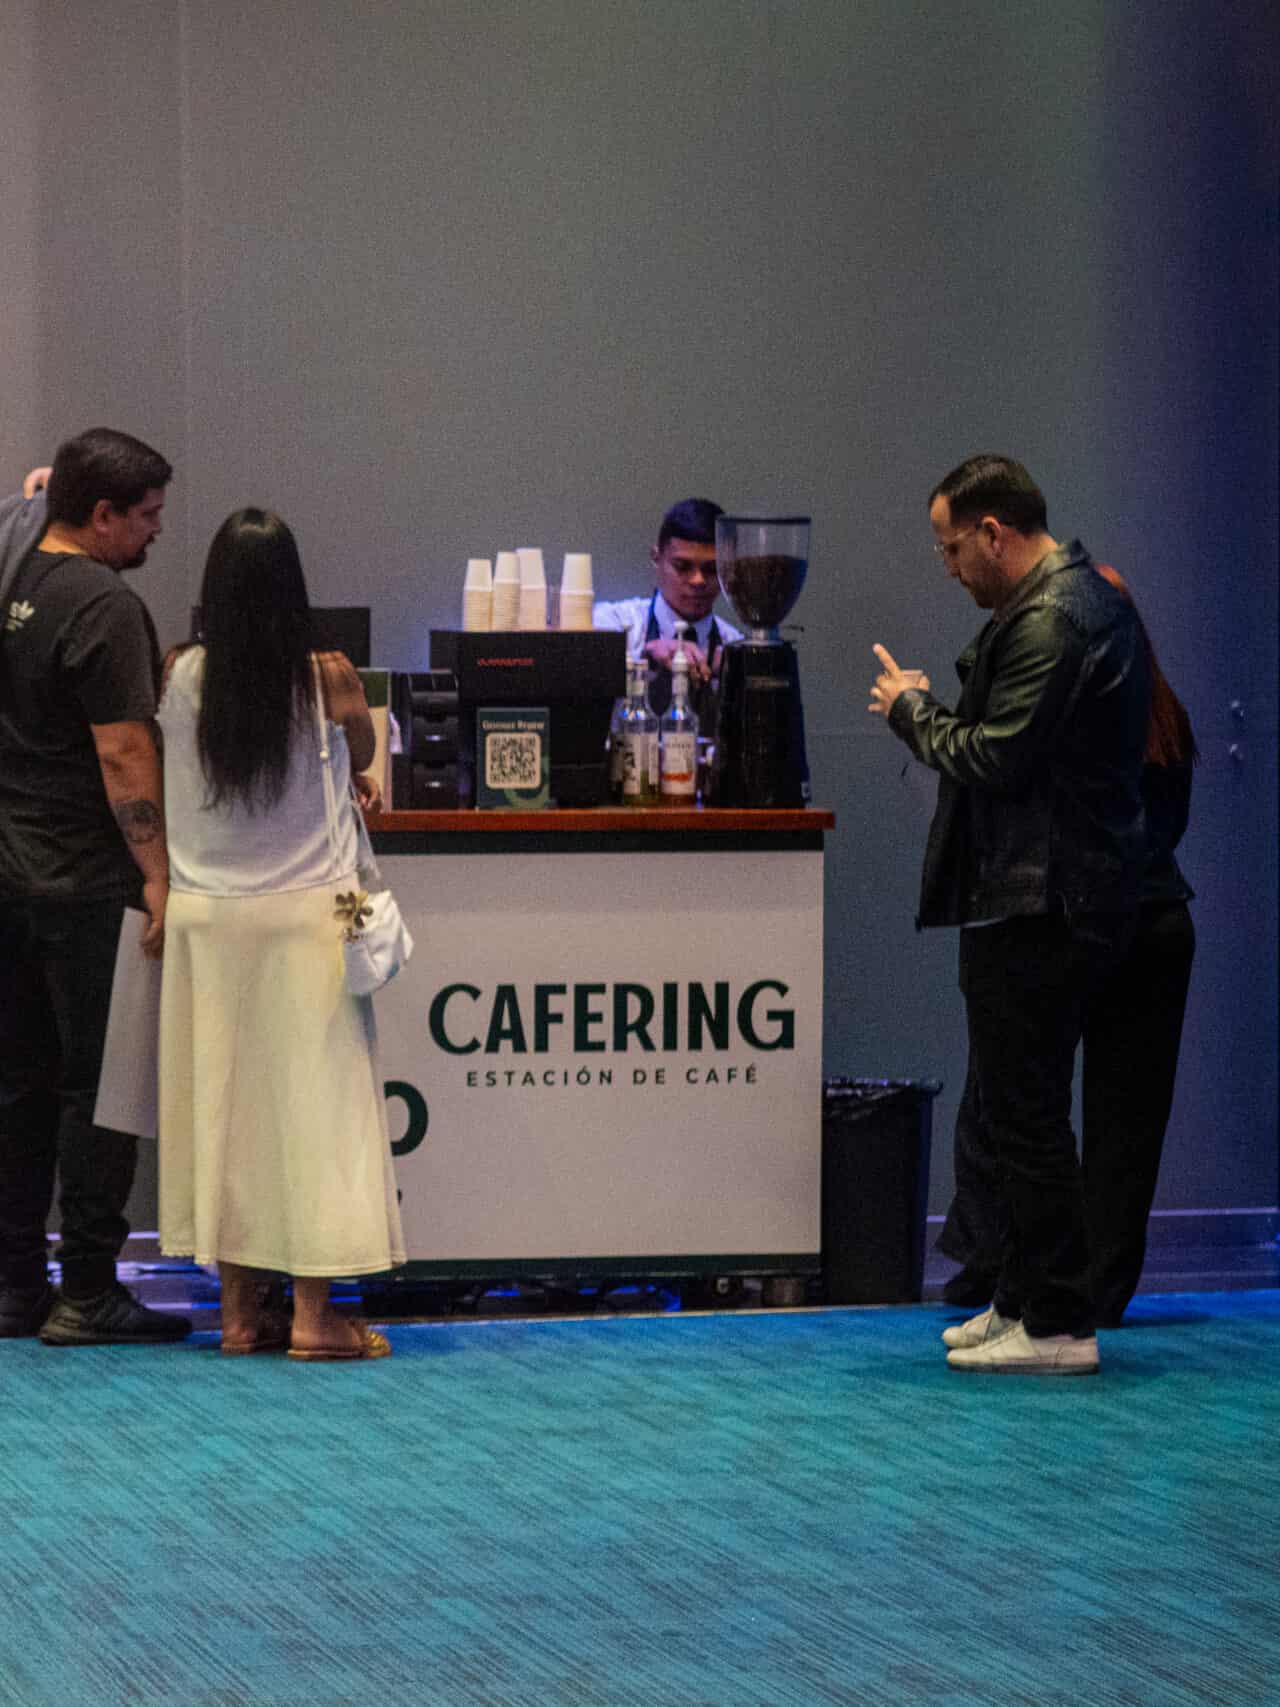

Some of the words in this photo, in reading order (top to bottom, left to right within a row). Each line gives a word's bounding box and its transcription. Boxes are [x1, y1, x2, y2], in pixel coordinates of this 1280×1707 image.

[428, 979, 796, 1056] CAFERING
[466, 1065, 614, 1088] ESTACIÓN
[632, 1067, 667, 1086] DE
[685, 1063, 758, 1085] CAFÉ
